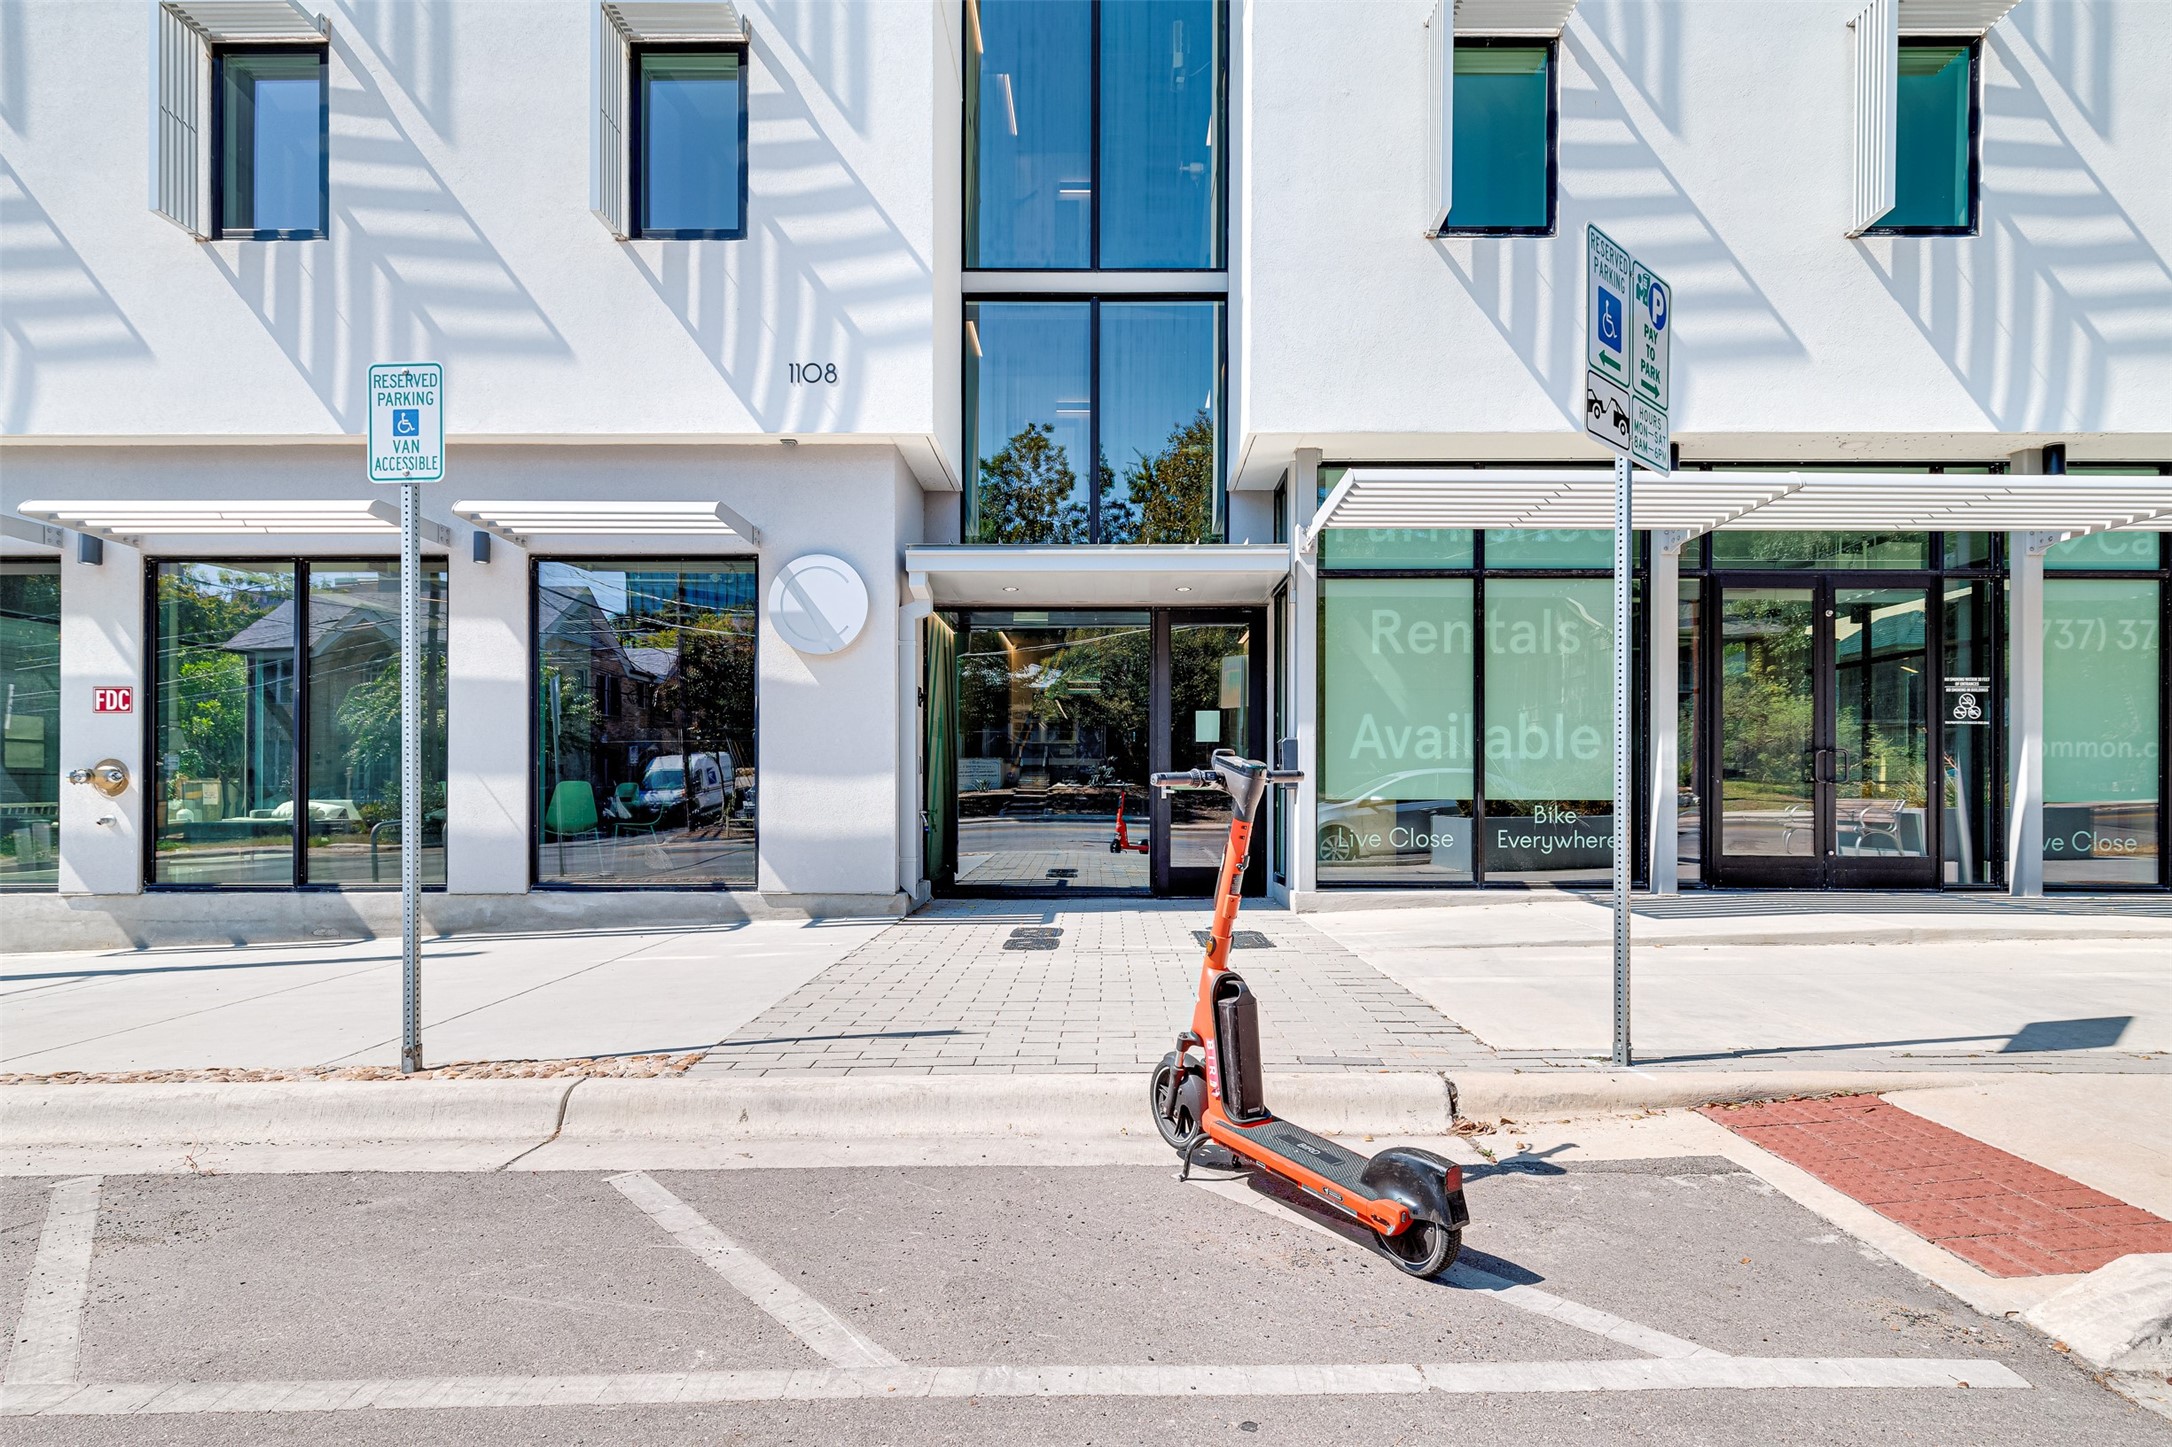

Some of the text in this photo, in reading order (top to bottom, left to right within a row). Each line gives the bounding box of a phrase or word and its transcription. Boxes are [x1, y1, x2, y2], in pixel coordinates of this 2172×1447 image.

[1590, 231, 1628, 275] RESERVED
[1594, 256, 1626, 294] PARKING
[1643, 323, 1659, 345] PAY
[1645, 343, 1656, 362] TO
[373, 373, 438, 389] RESERVED
[788, 362, 838, 384] 1108
[1640, 358, 1661, 385] PARK
[377, 391, 434, 407] PARKING
[1639, 406, 1662, 431] HOURS
[392, 439, 420, 454] VAN
[374, 455, 438, 472] ACCESSIBLE
[1371, 608, 1581, 655] Rentals
[95, 689, 130, 711] FDC
[1349, 712, 1601, 760] Available
[1534, 804, 1578, 824] Bike
[1338, 826, 1455, 848] Live Close
[1497, 829, 1615, 855] Everywhere
[2071, 830, 2138, 852] Close
